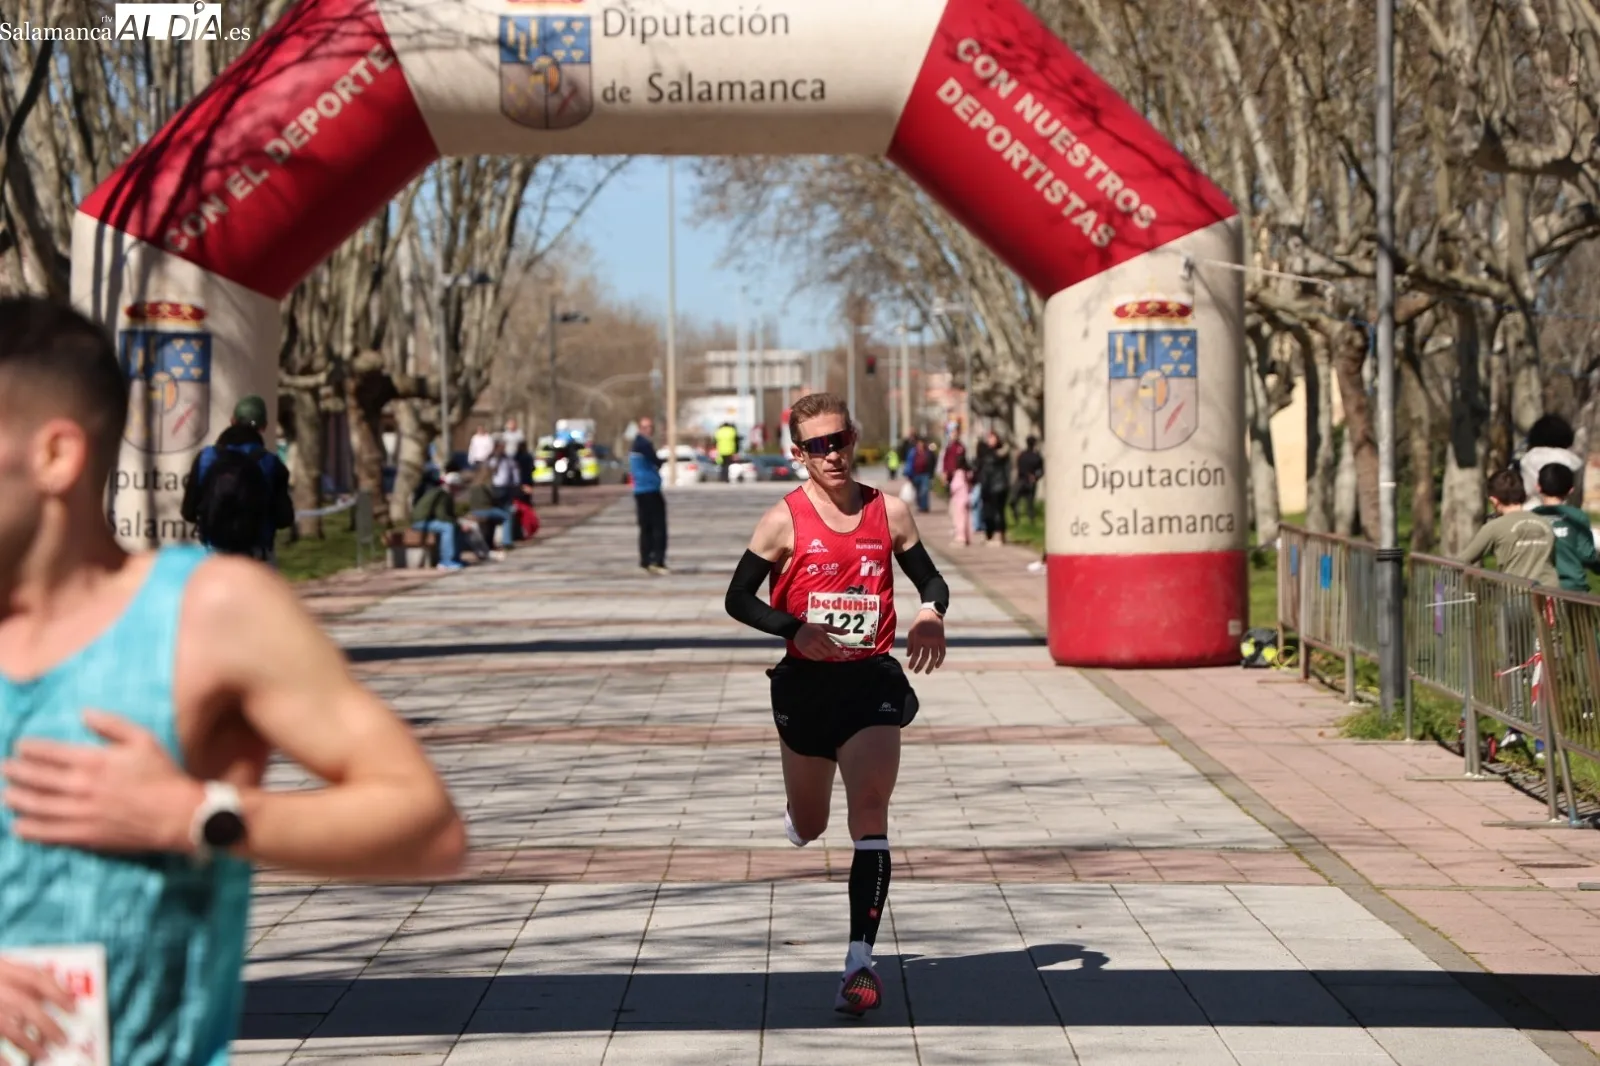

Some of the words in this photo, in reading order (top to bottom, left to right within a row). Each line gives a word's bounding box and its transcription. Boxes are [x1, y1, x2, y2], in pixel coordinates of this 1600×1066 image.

[602, 7, 790, 45] Diputación
[602, 80, 632, 105] de
[647, 72, 827, 104] Salamanca
[163, 193, 229, 252] CON
[224, 163, 270, 202] EL
[263, 42, 396, 165] DEPORTE
[956, 37, 1019, 99] CON
[1013, 92, 1157, 229] NUESTROS
[936, 76, 1117, 248] DEPORTISTAS
[1082, 460, 1226, 495] Diputación
[1070, 515, 1090, 537] de
[1100, 508, 1236, 537] Salamanca
[810, 596, 878, 611] bedunia
[824, 612, 865, 634] 122
